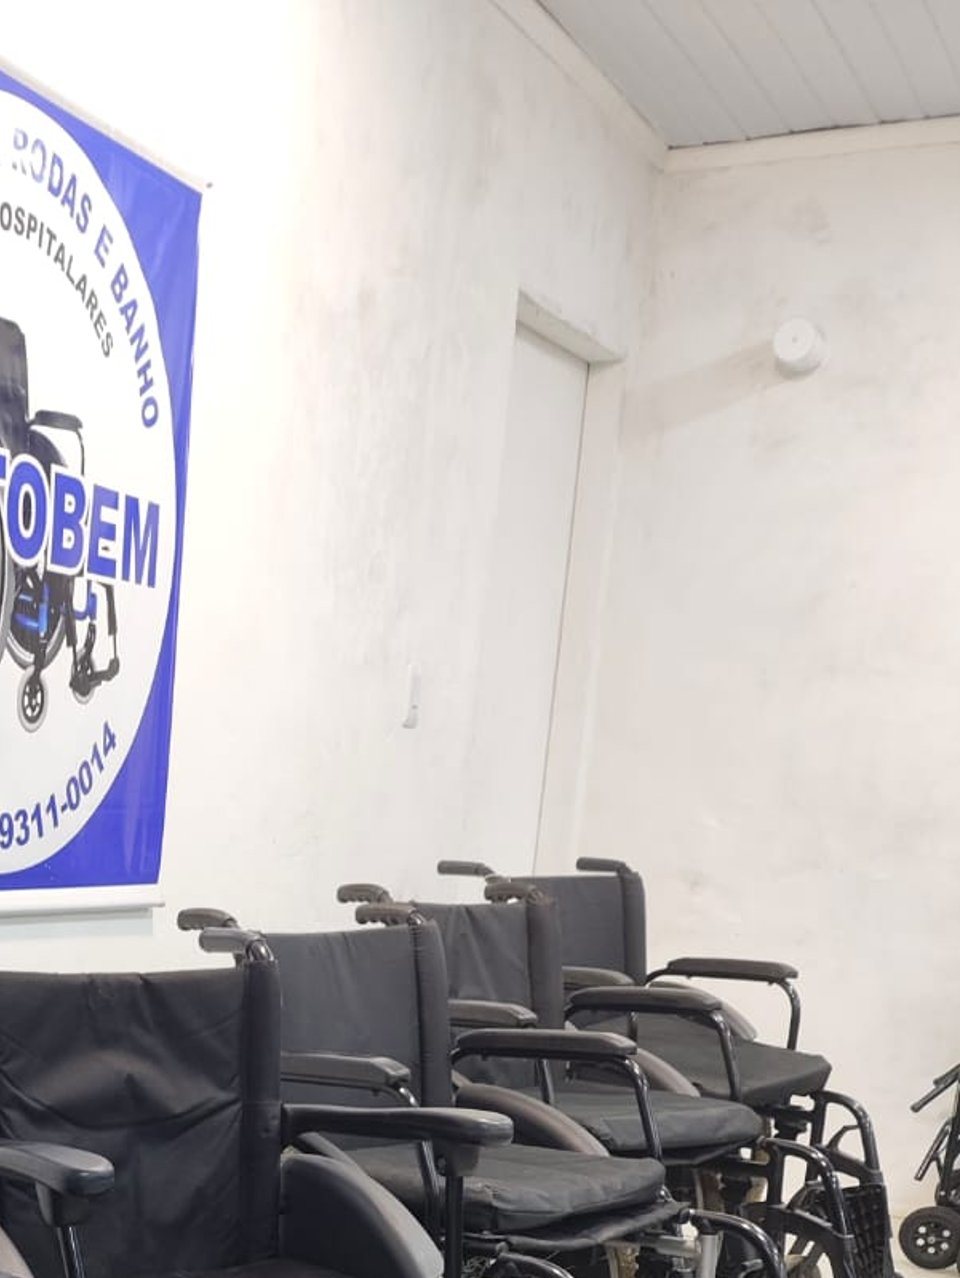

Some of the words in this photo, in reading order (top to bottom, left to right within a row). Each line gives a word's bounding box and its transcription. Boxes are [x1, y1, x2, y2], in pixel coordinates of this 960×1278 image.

[12, 128, 92, 234] RODAS
[94, 226, 114, 268] E
[111, 264, 159, 429] BANHO
